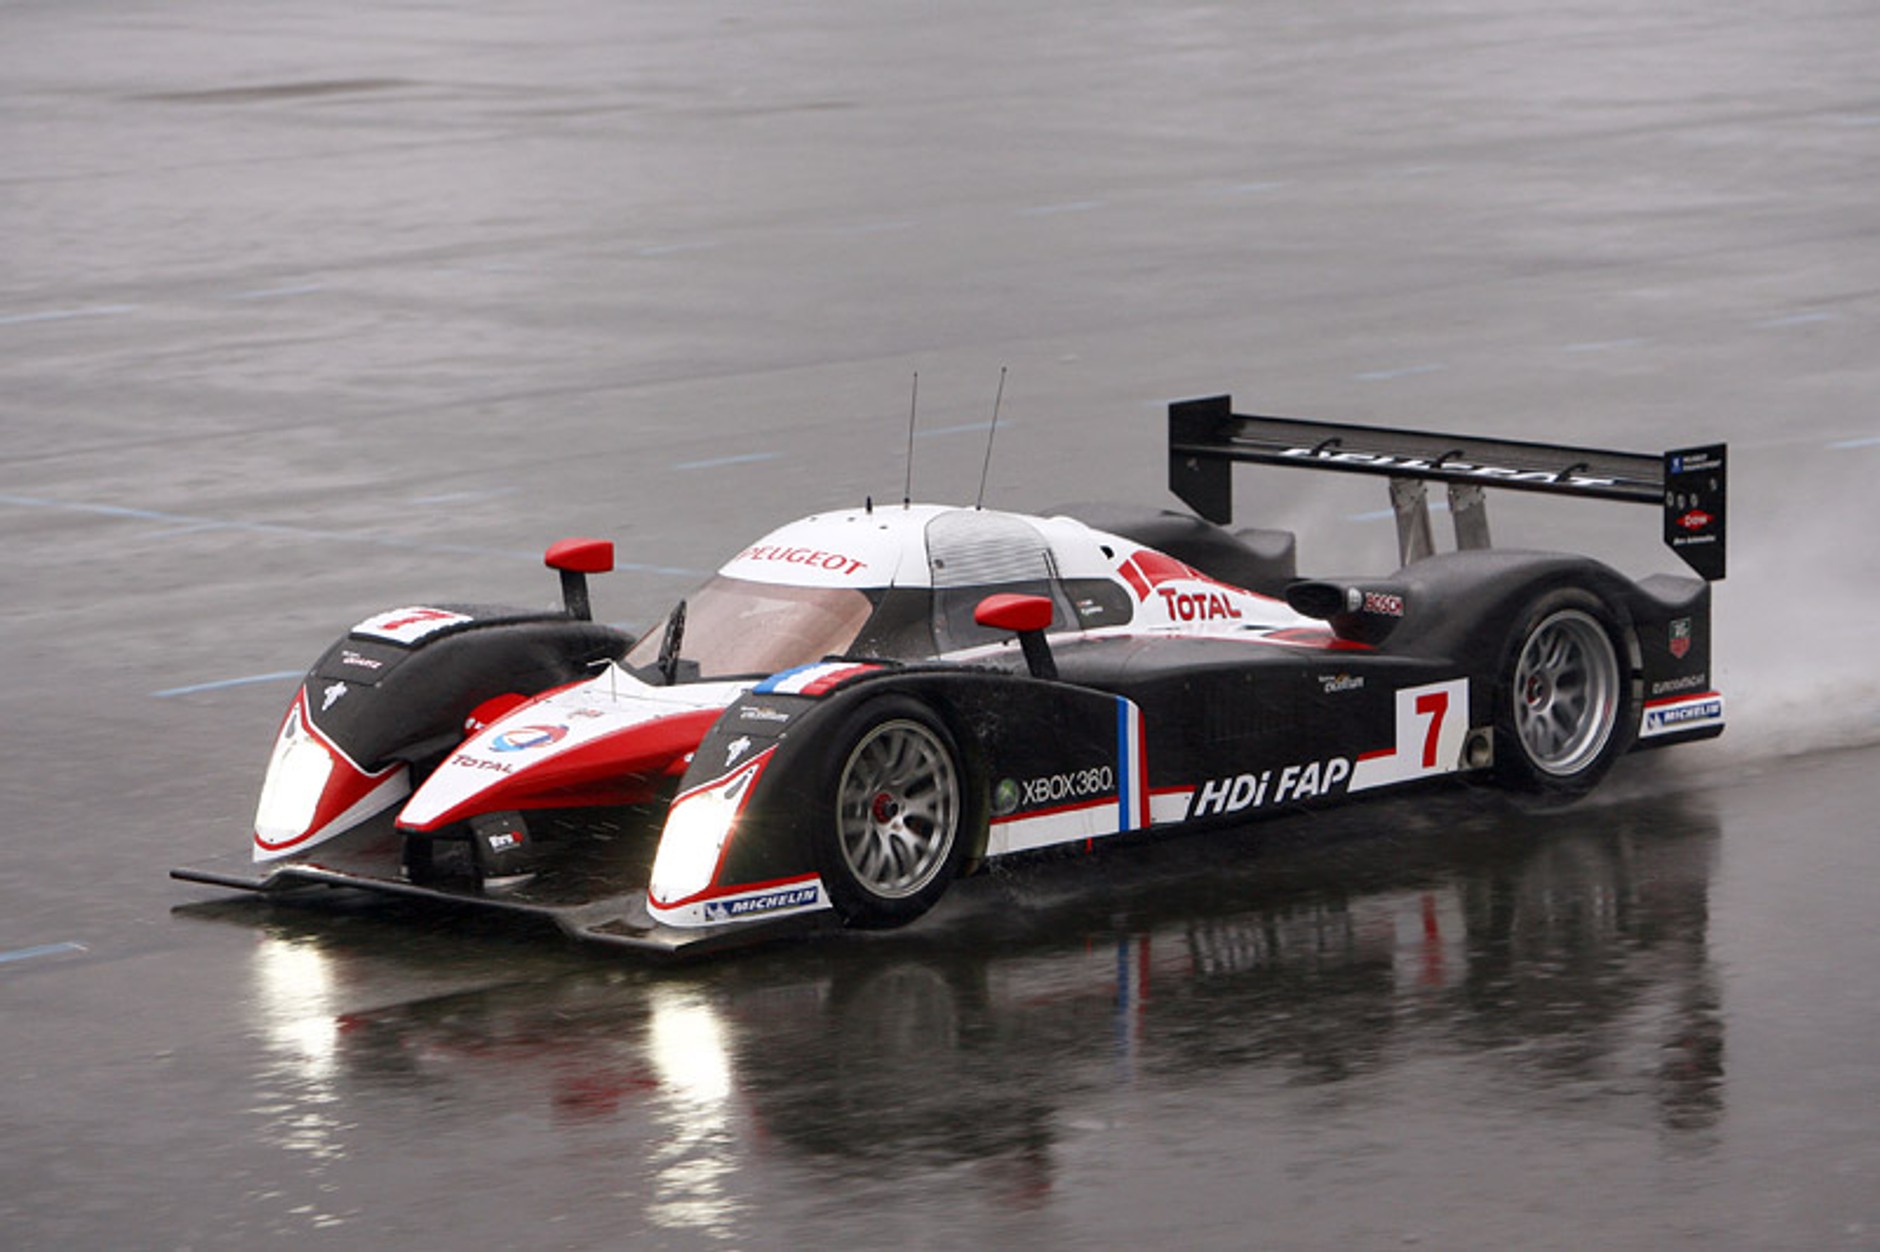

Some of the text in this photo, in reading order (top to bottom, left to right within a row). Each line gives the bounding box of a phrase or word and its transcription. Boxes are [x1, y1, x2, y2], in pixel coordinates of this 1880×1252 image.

[737, 545, 868, 575] PEUGEOT
[379, 610, 454, 631] 7
[1158, 587, 1242, 622] TOTAL
[1415, 690, 1449, 769] 7
[451, 754, 513, 774] TOTAL
[1021, 765, 1113, 806] XBOX 360
[1194, 756, 1351, 817] HDi FAP
[731, 888, 816, 914] MICHELIN
